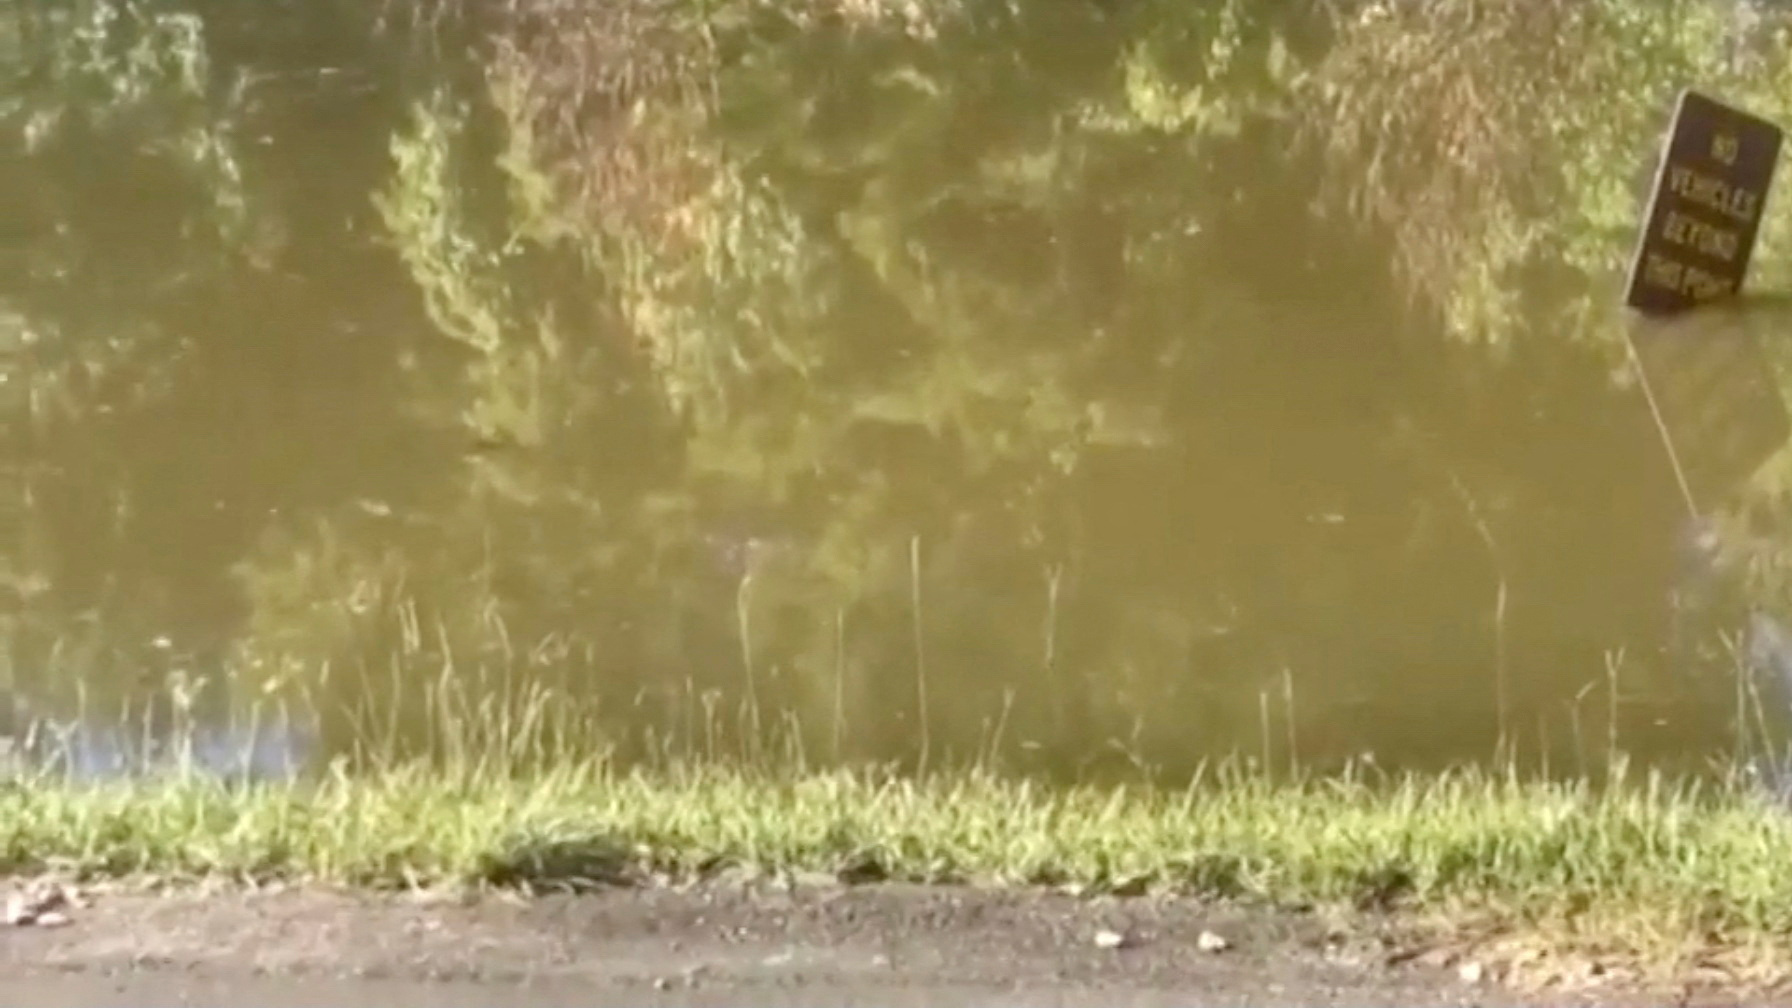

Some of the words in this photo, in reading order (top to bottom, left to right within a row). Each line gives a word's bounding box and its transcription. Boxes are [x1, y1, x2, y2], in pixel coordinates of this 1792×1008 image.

[1711, 134, 1738, 166] NO
[1671, 166, 1757, 221] VEHICLES
[1662, 211, 1738, 260] BEYOND
